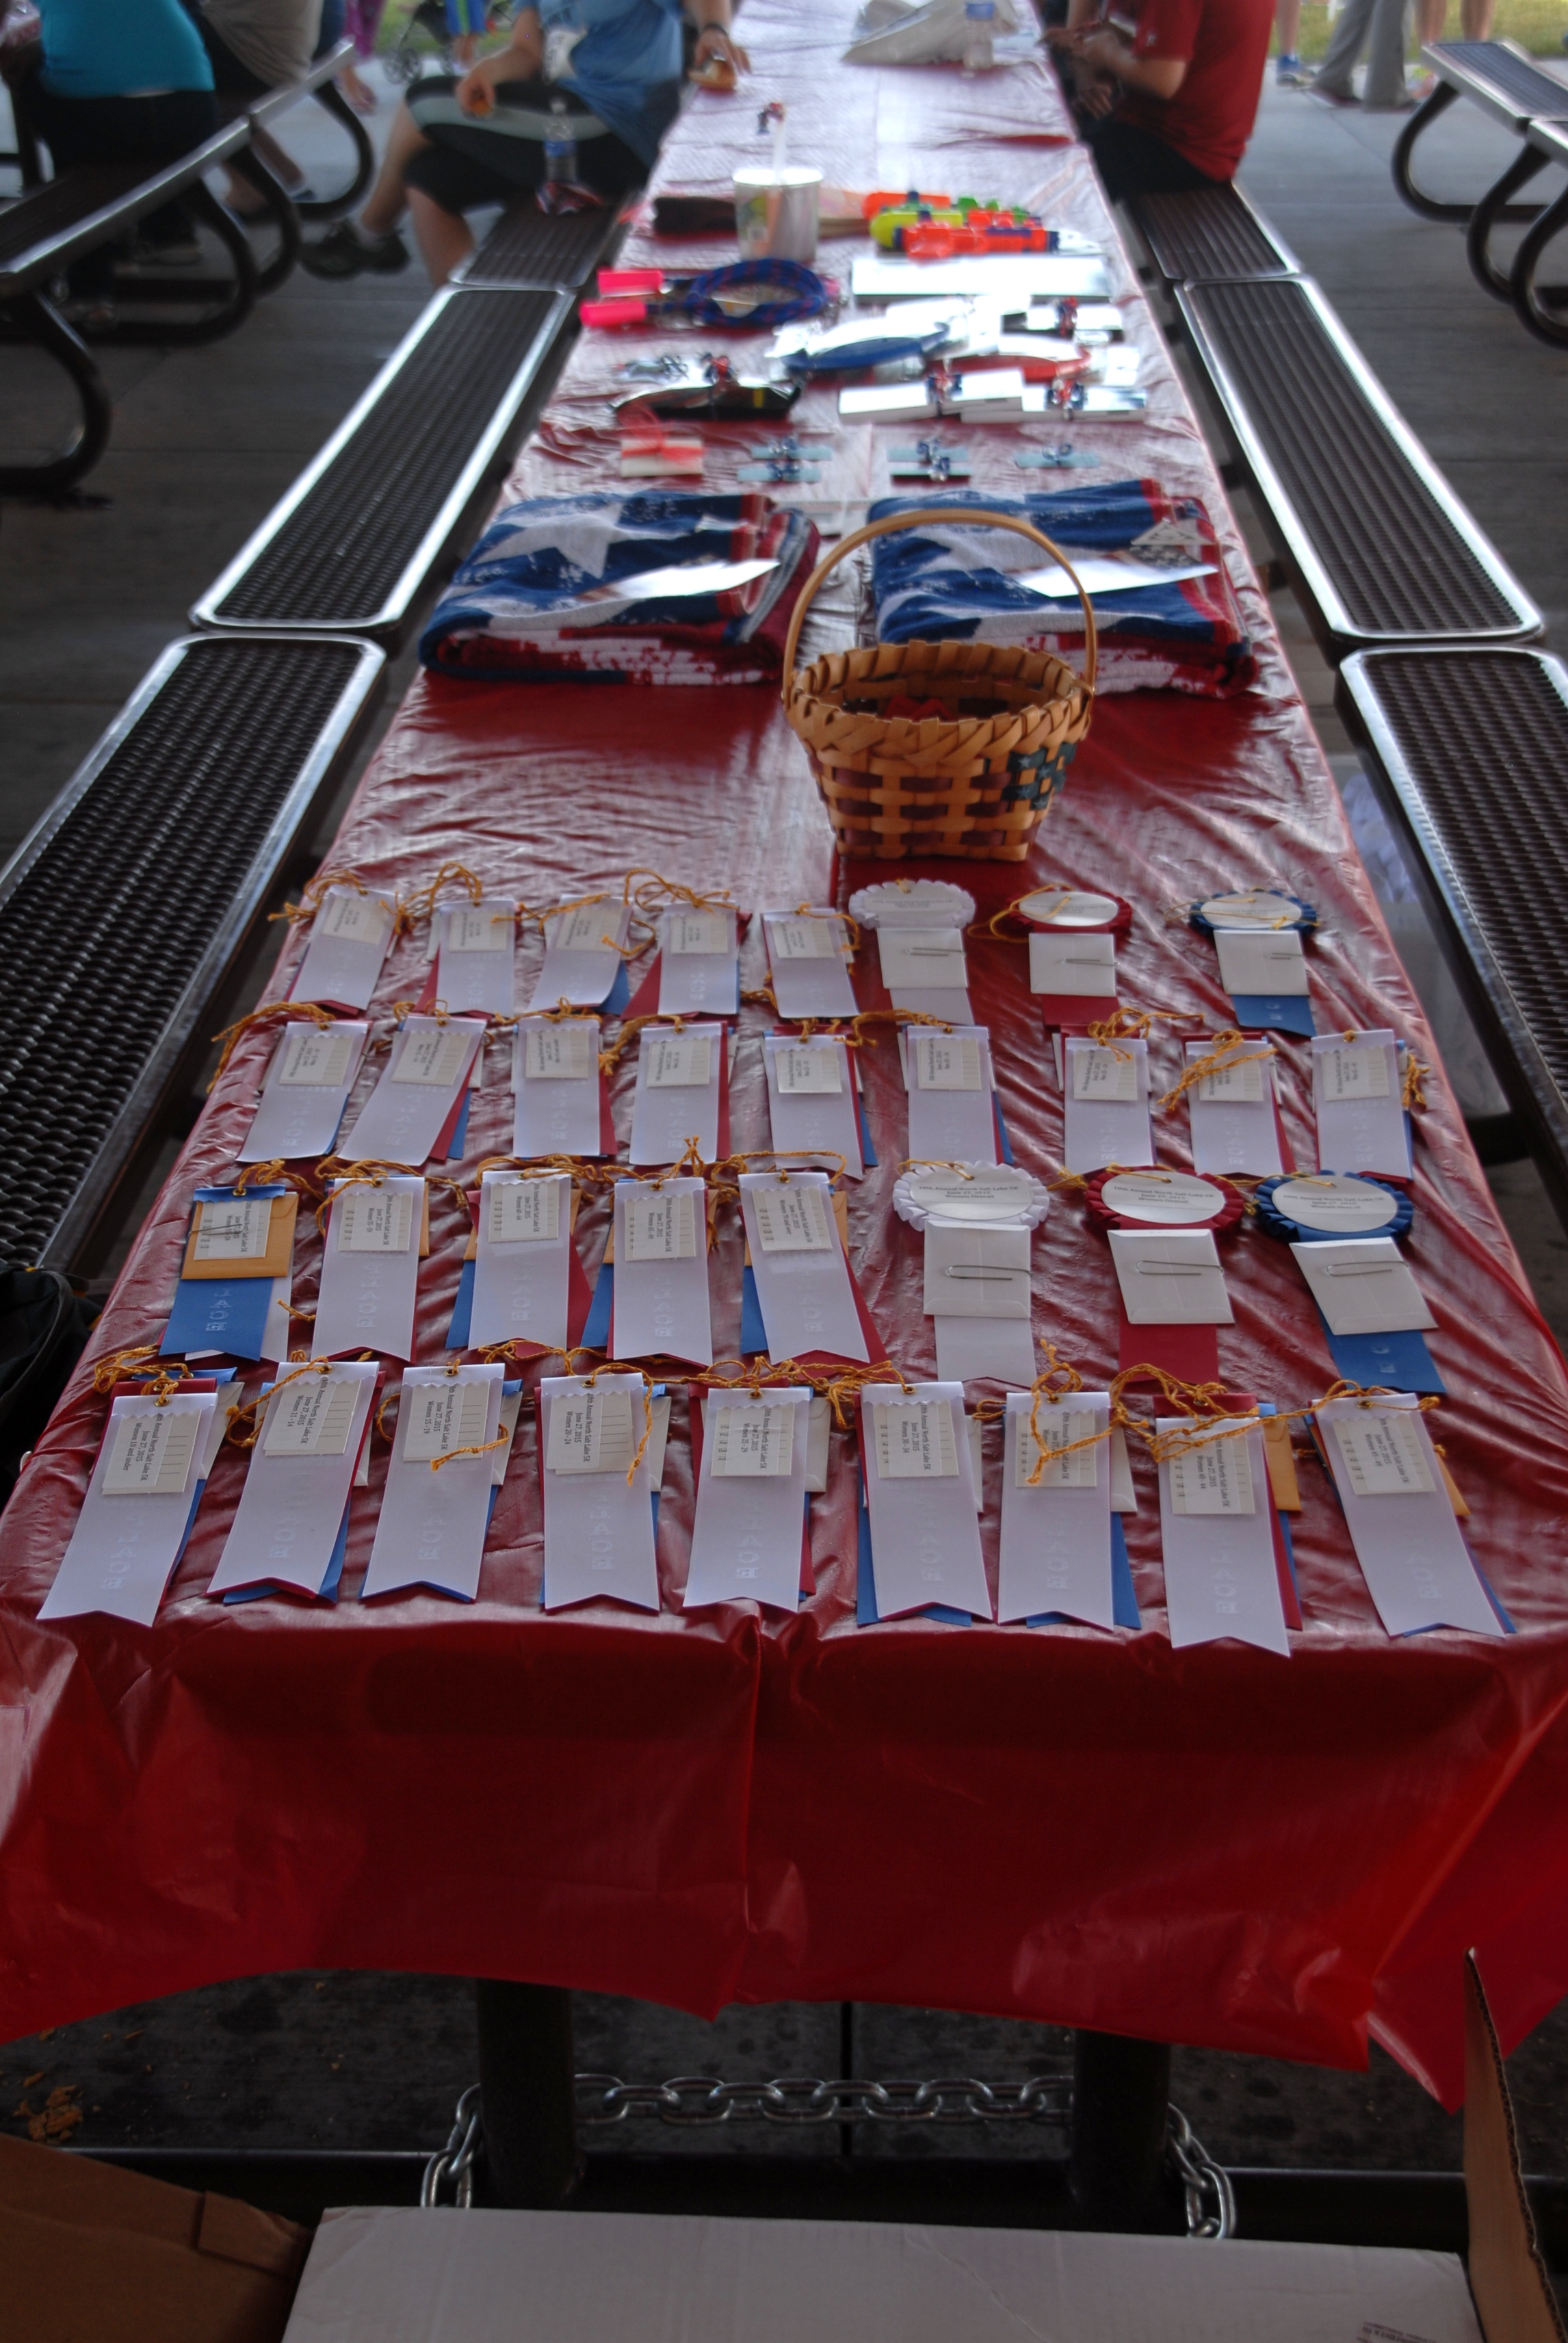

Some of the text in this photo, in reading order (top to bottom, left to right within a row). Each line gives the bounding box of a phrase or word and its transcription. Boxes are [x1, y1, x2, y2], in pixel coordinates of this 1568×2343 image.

[304, 1397, 313, 1406] June
[314, 1389, 326, 1404] Annual
[446, 1394, 454, 1410] Annual
[292, 1395, 304, 1412] Women
[426, 1400, 434, 1418] Women
[436, 1402, 444, 1412] June
[310, 1405, 320, 1417] North
[445, 1410, 453, 1423] North
[297, 1414, 307, 1425] 2015
[306, 1418, 315, 1426] Salt
[565, 1411, 573, 1428] Women
[575, 1412, 583, 1423] June
[131, 1423, 142, 1440] Women
[152, 1423, 162, 1438] Annual
[303, 1427, 313, 1437] Lake
[433, 1421, 441, 1432] 2015
[141, 1431, 151, 1441] June
[441, 1432, 449, 1443] Lake
[148, 1440, 158, 1453] North
[135, 1450, 145, 1462] 2015
[146, 1453, 154, 1462] Salt
[123, 1457, 131, 1471] under
[142, 1463, 152, 1473] Lake
